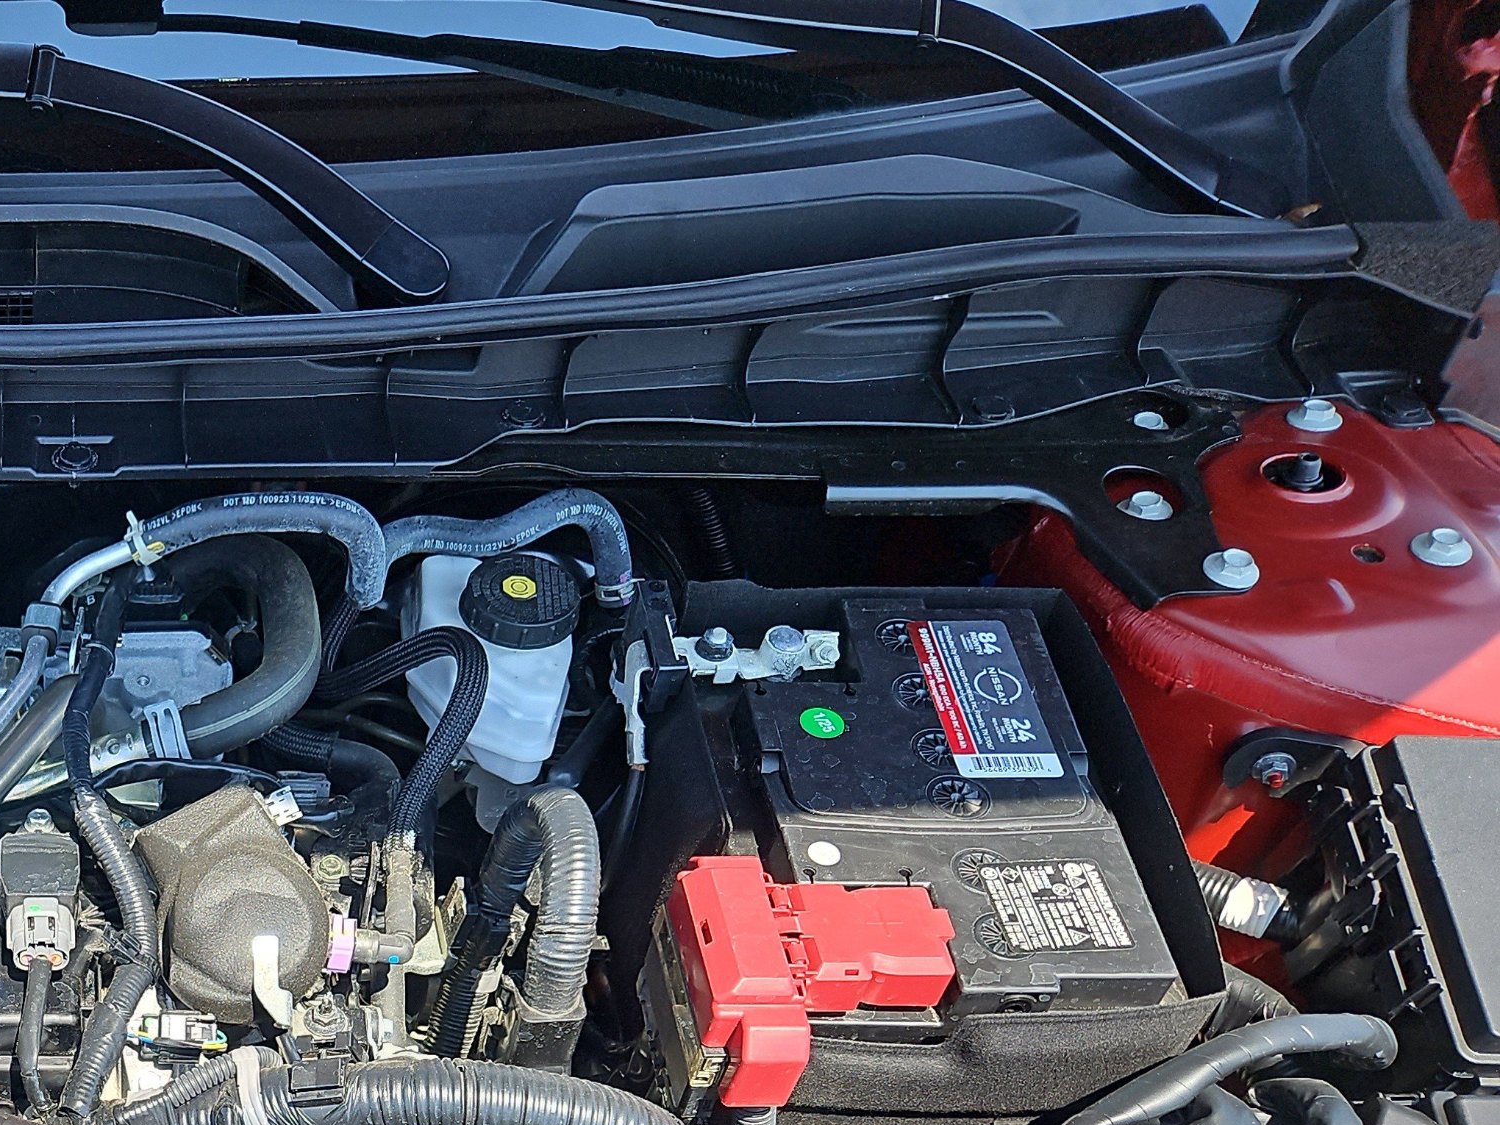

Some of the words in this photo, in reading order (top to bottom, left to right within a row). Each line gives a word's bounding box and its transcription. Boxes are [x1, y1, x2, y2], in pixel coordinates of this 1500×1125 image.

[223, 497, 240, 508] DOT
[258, 494, 290, 505] 100923
[555, 508, 569, 522] DOT
[445, 541, 472, 552] 100923
[968, 631, 984, 655] MONTH
[977, 631, 1003, 654] 84
[918, 627, 947, 683] 999M1-NBH5A
[986, 667, 1009, 705] NISSAN
[813, 712, 836, 733] 1/25
[1001, 717, 1018, 743] MONTH
[1011, 718, 1037, 742] 24
